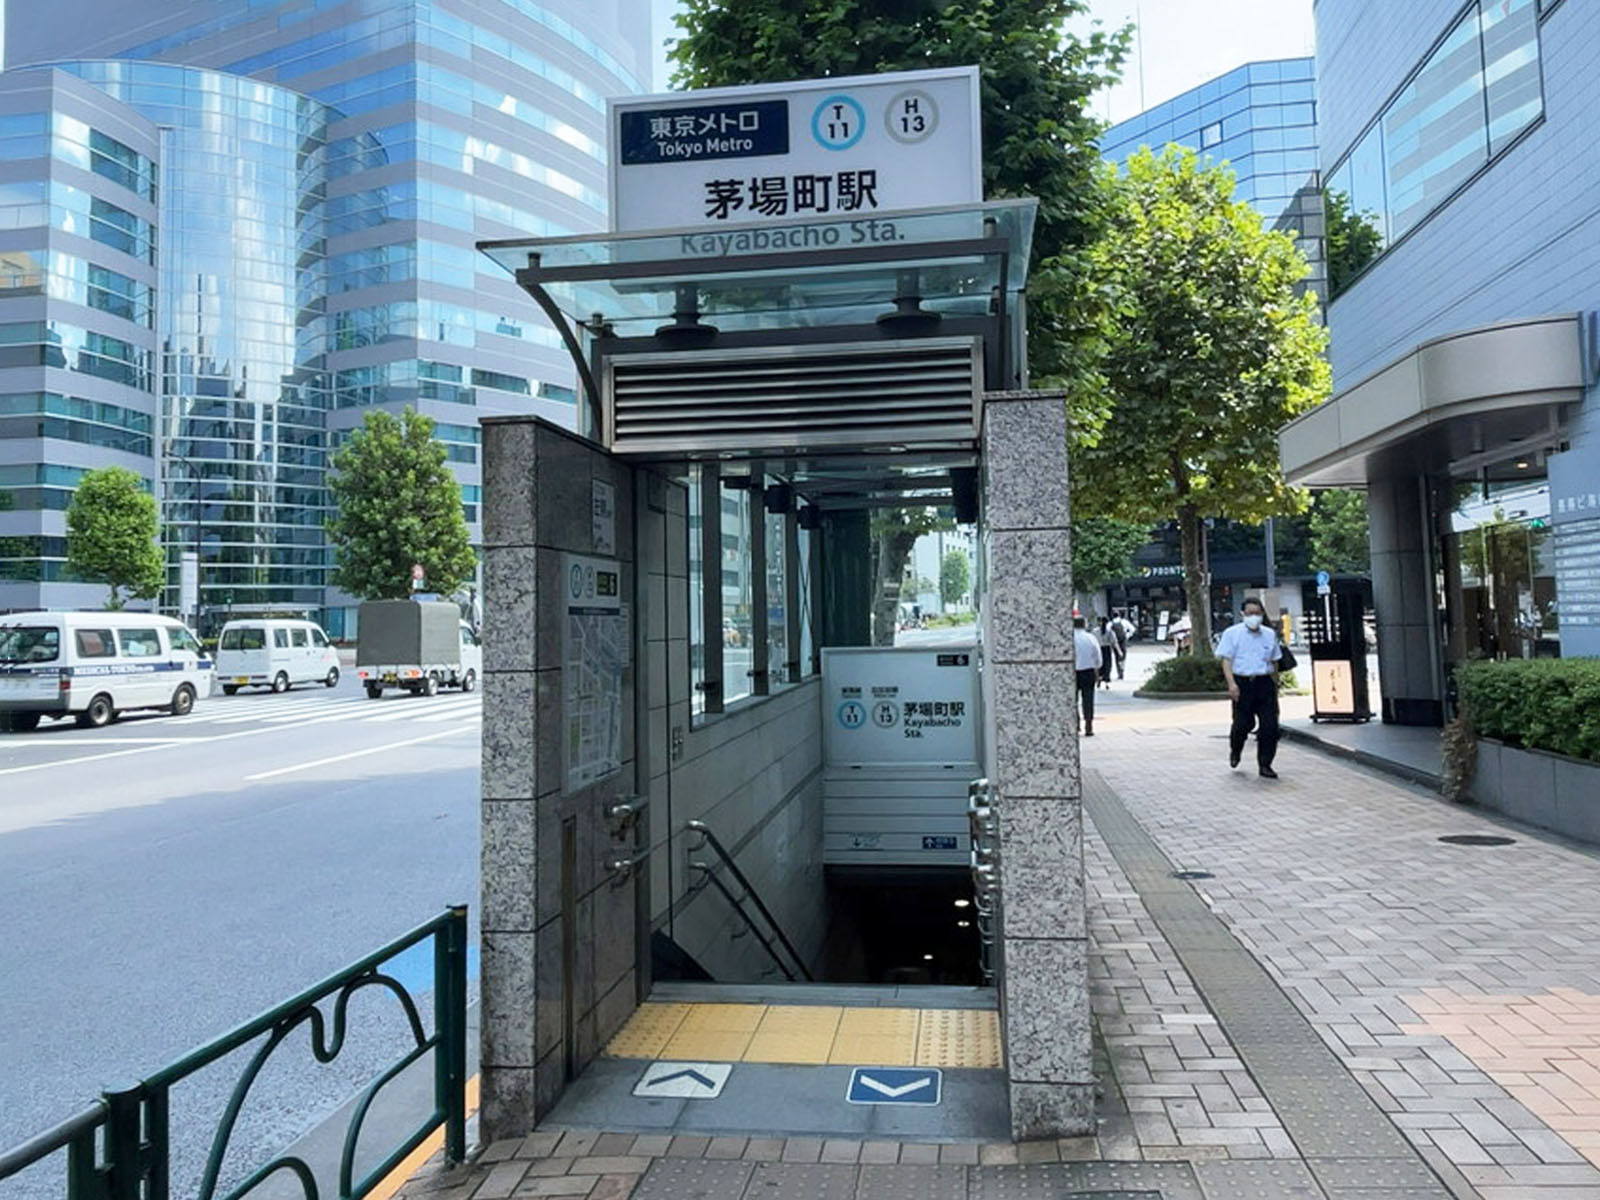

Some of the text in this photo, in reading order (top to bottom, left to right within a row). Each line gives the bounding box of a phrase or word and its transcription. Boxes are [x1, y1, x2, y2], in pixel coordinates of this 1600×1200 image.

[832, 105, 843, 121] T
[904, 98, 919, 115] H
[650, 110, 759, 139] 東京メトロ
[827, 121, 850, 139] 11
[900, 115, 926, 134] 13
[657, 136, 753, 158] Tokyo Metro
[704, 169, 878, 220] 茅場町駅
[681, 219, 905, 256] Kayabacho Sta.
[849, 705, 855, 714] T
[881, 705, 890, 713] H
[904, 701, 965, 717] 茅場町駅
[880, 714, 893, 723] 13
[904, 718, 961, 728] Kayabacho
[904, 729, 924, 738] Sta.
